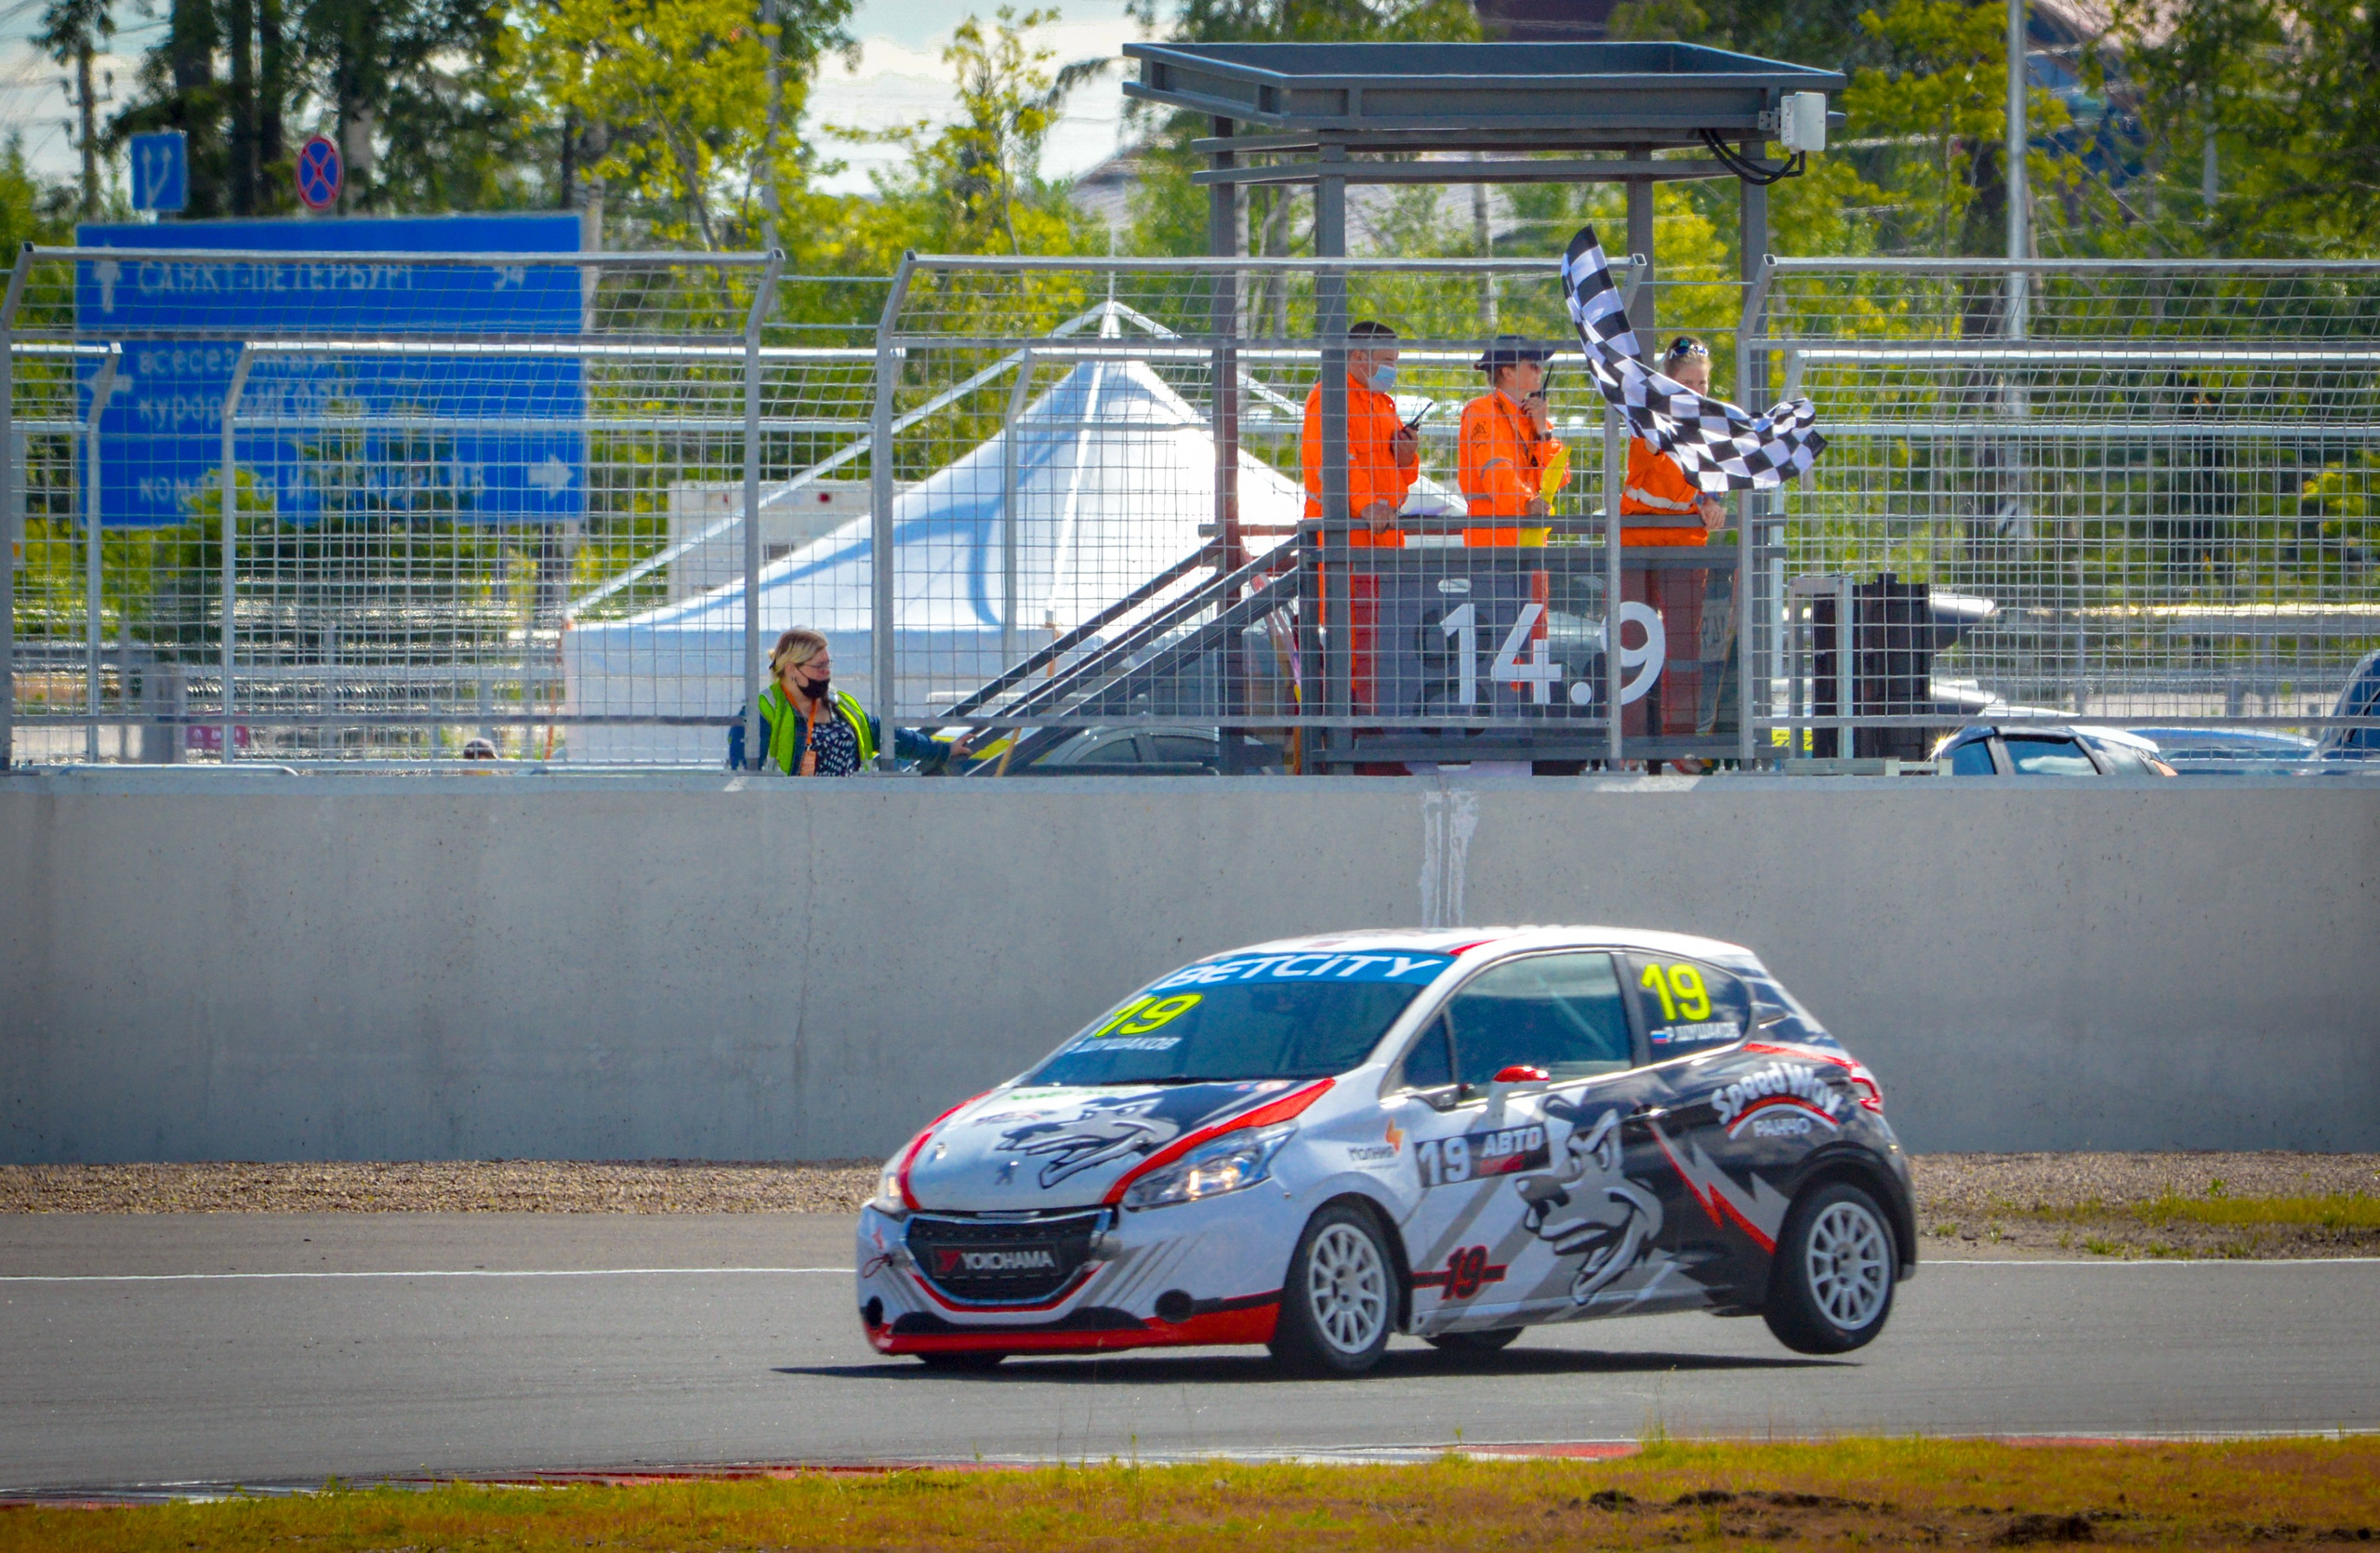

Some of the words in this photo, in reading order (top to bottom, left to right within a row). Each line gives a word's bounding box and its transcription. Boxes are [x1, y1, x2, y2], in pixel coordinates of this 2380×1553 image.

[1439, 601, 1667, 706] 14.9
[1093, 992, 1205, 1039] 19
[1641, 962, 1712, 1022] 19
[1482, 1126, 1544, 1159] АВТО
[1752, 1117, 1813, 1138] РАНЧО
[1418, 1136, 1472, 1187] 19
[1440, 1244, 1488, 1301] 19
